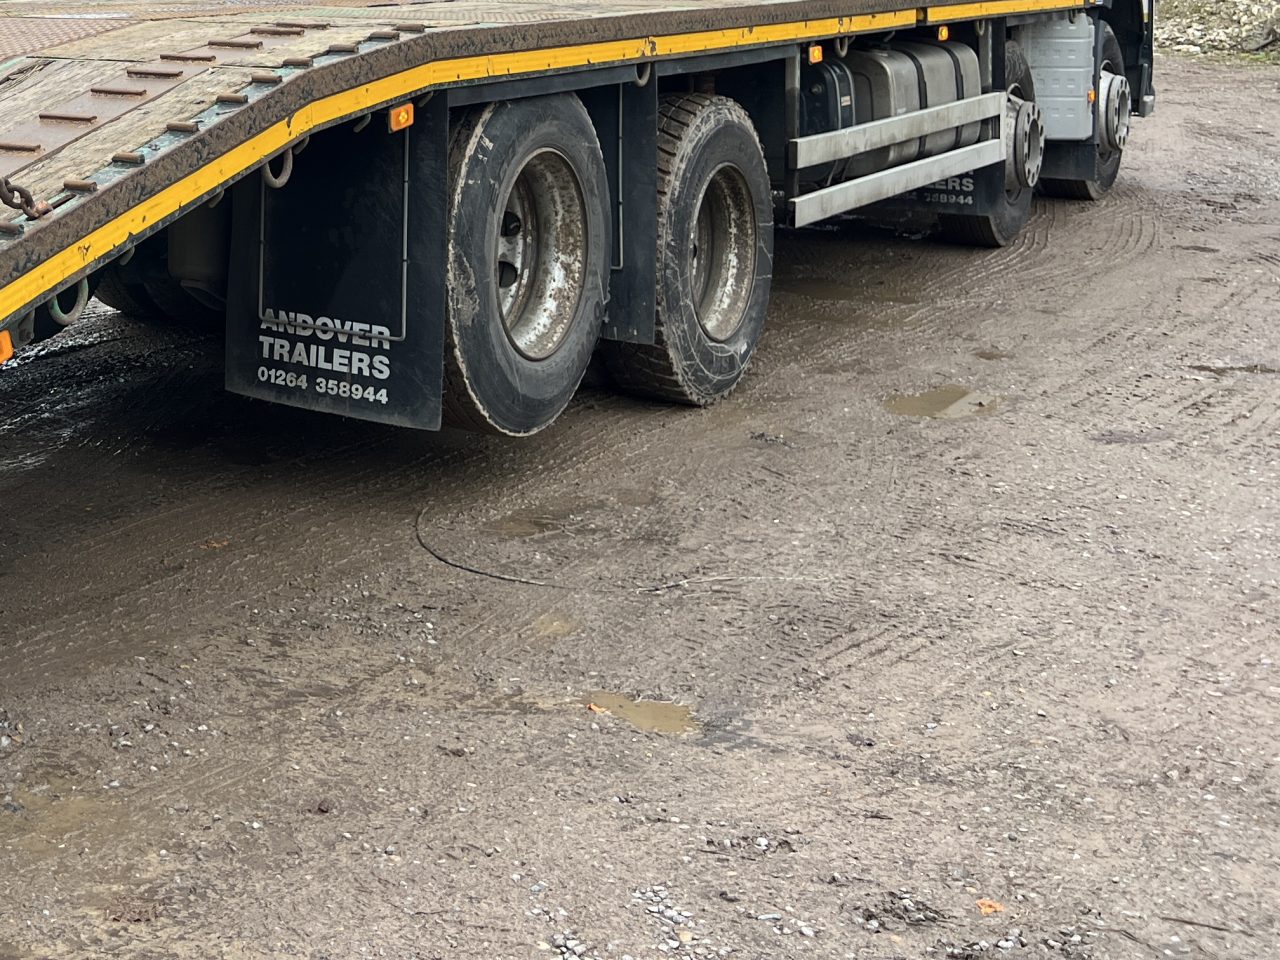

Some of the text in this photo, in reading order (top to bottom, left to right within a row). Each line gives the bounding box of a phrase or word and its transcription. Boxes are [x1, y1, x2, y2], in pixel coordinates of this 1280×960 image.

[260, 308, 391, 349] ANDOVER
[259, 335, 391, 380] TRAILERS
[257, 366, 389, 404] 01264 358944
